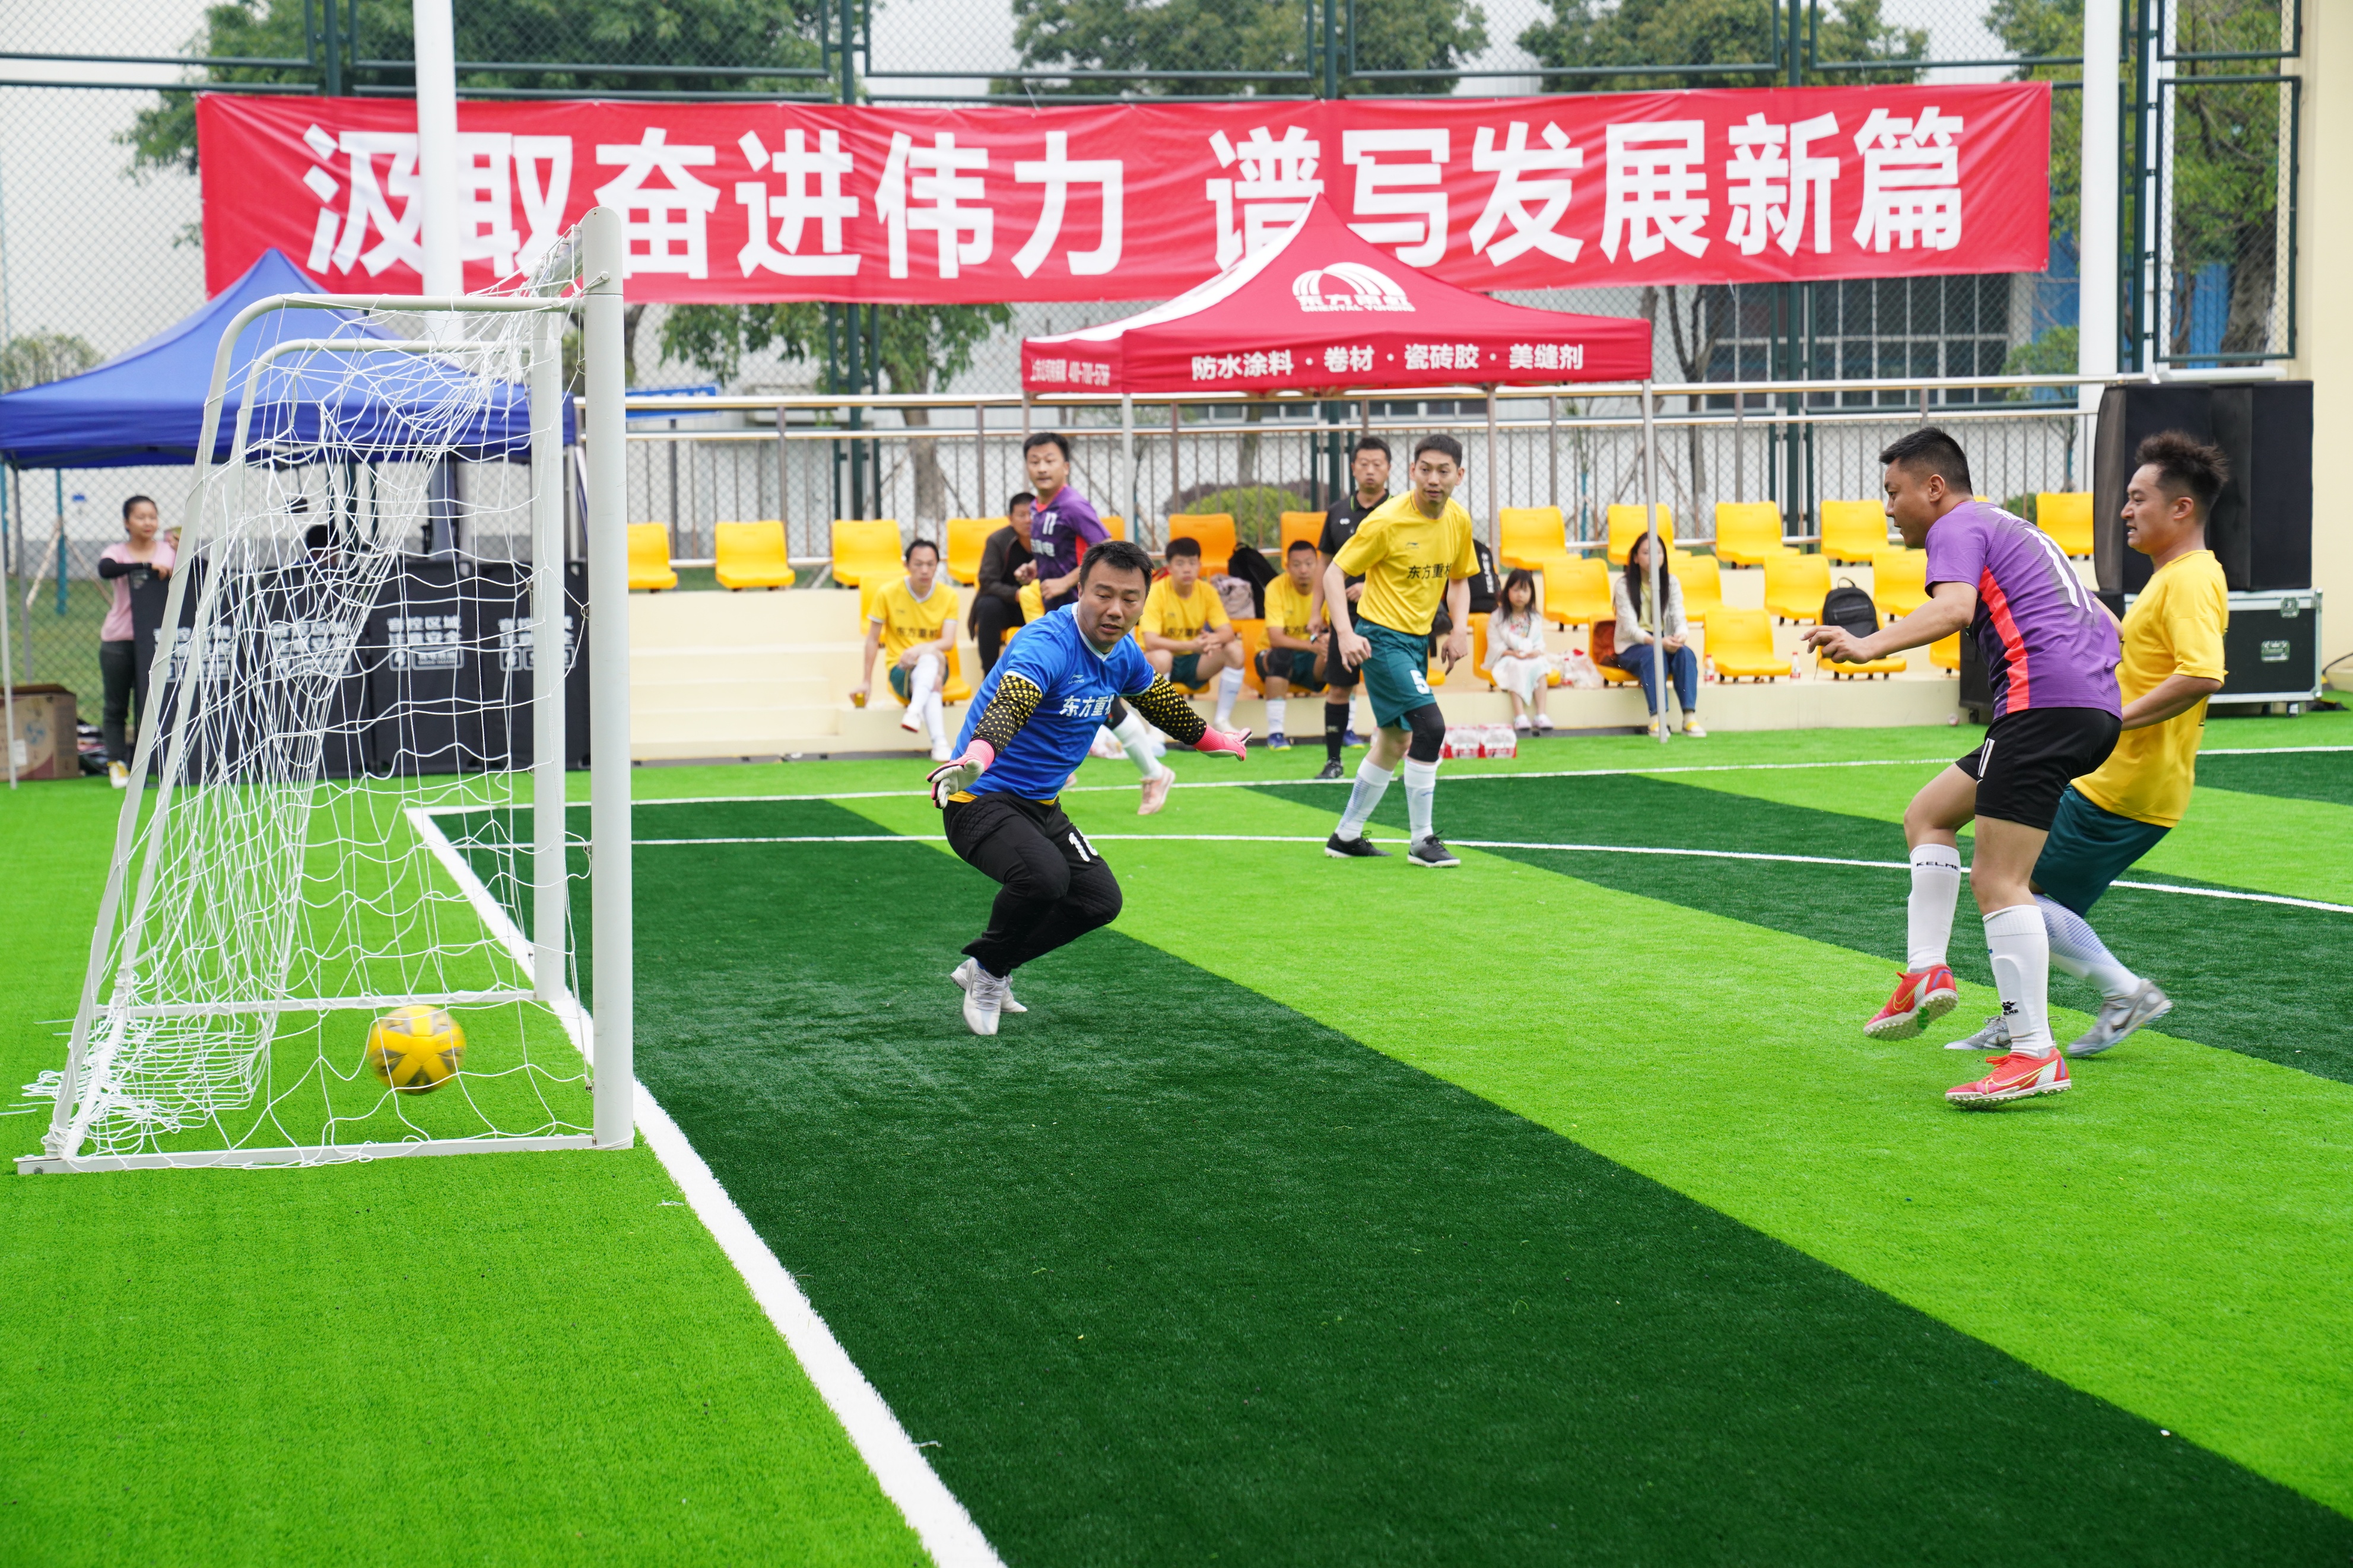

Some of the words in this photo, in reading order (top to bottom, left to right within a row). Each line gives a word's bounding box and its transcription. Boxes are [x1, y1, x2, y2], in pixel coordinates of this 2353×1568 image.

[303, 123, 1124, 279] 汲取奋进伟力
[1206, 106, 1964, 271] 谱写发展新篇
[1192, 349, 1294, 381] 防水涂料
[1324, 345, 1375, 373] 卷材
[1404, 343, 1479, 370] 瓷砖胶
[1509, 343, 1583, 370] 美缝剂
[1410, 670, 1430, 694] 5
[1977, 737, 1995, 778] 11
[1916, 861, 1959, 872] KELME
